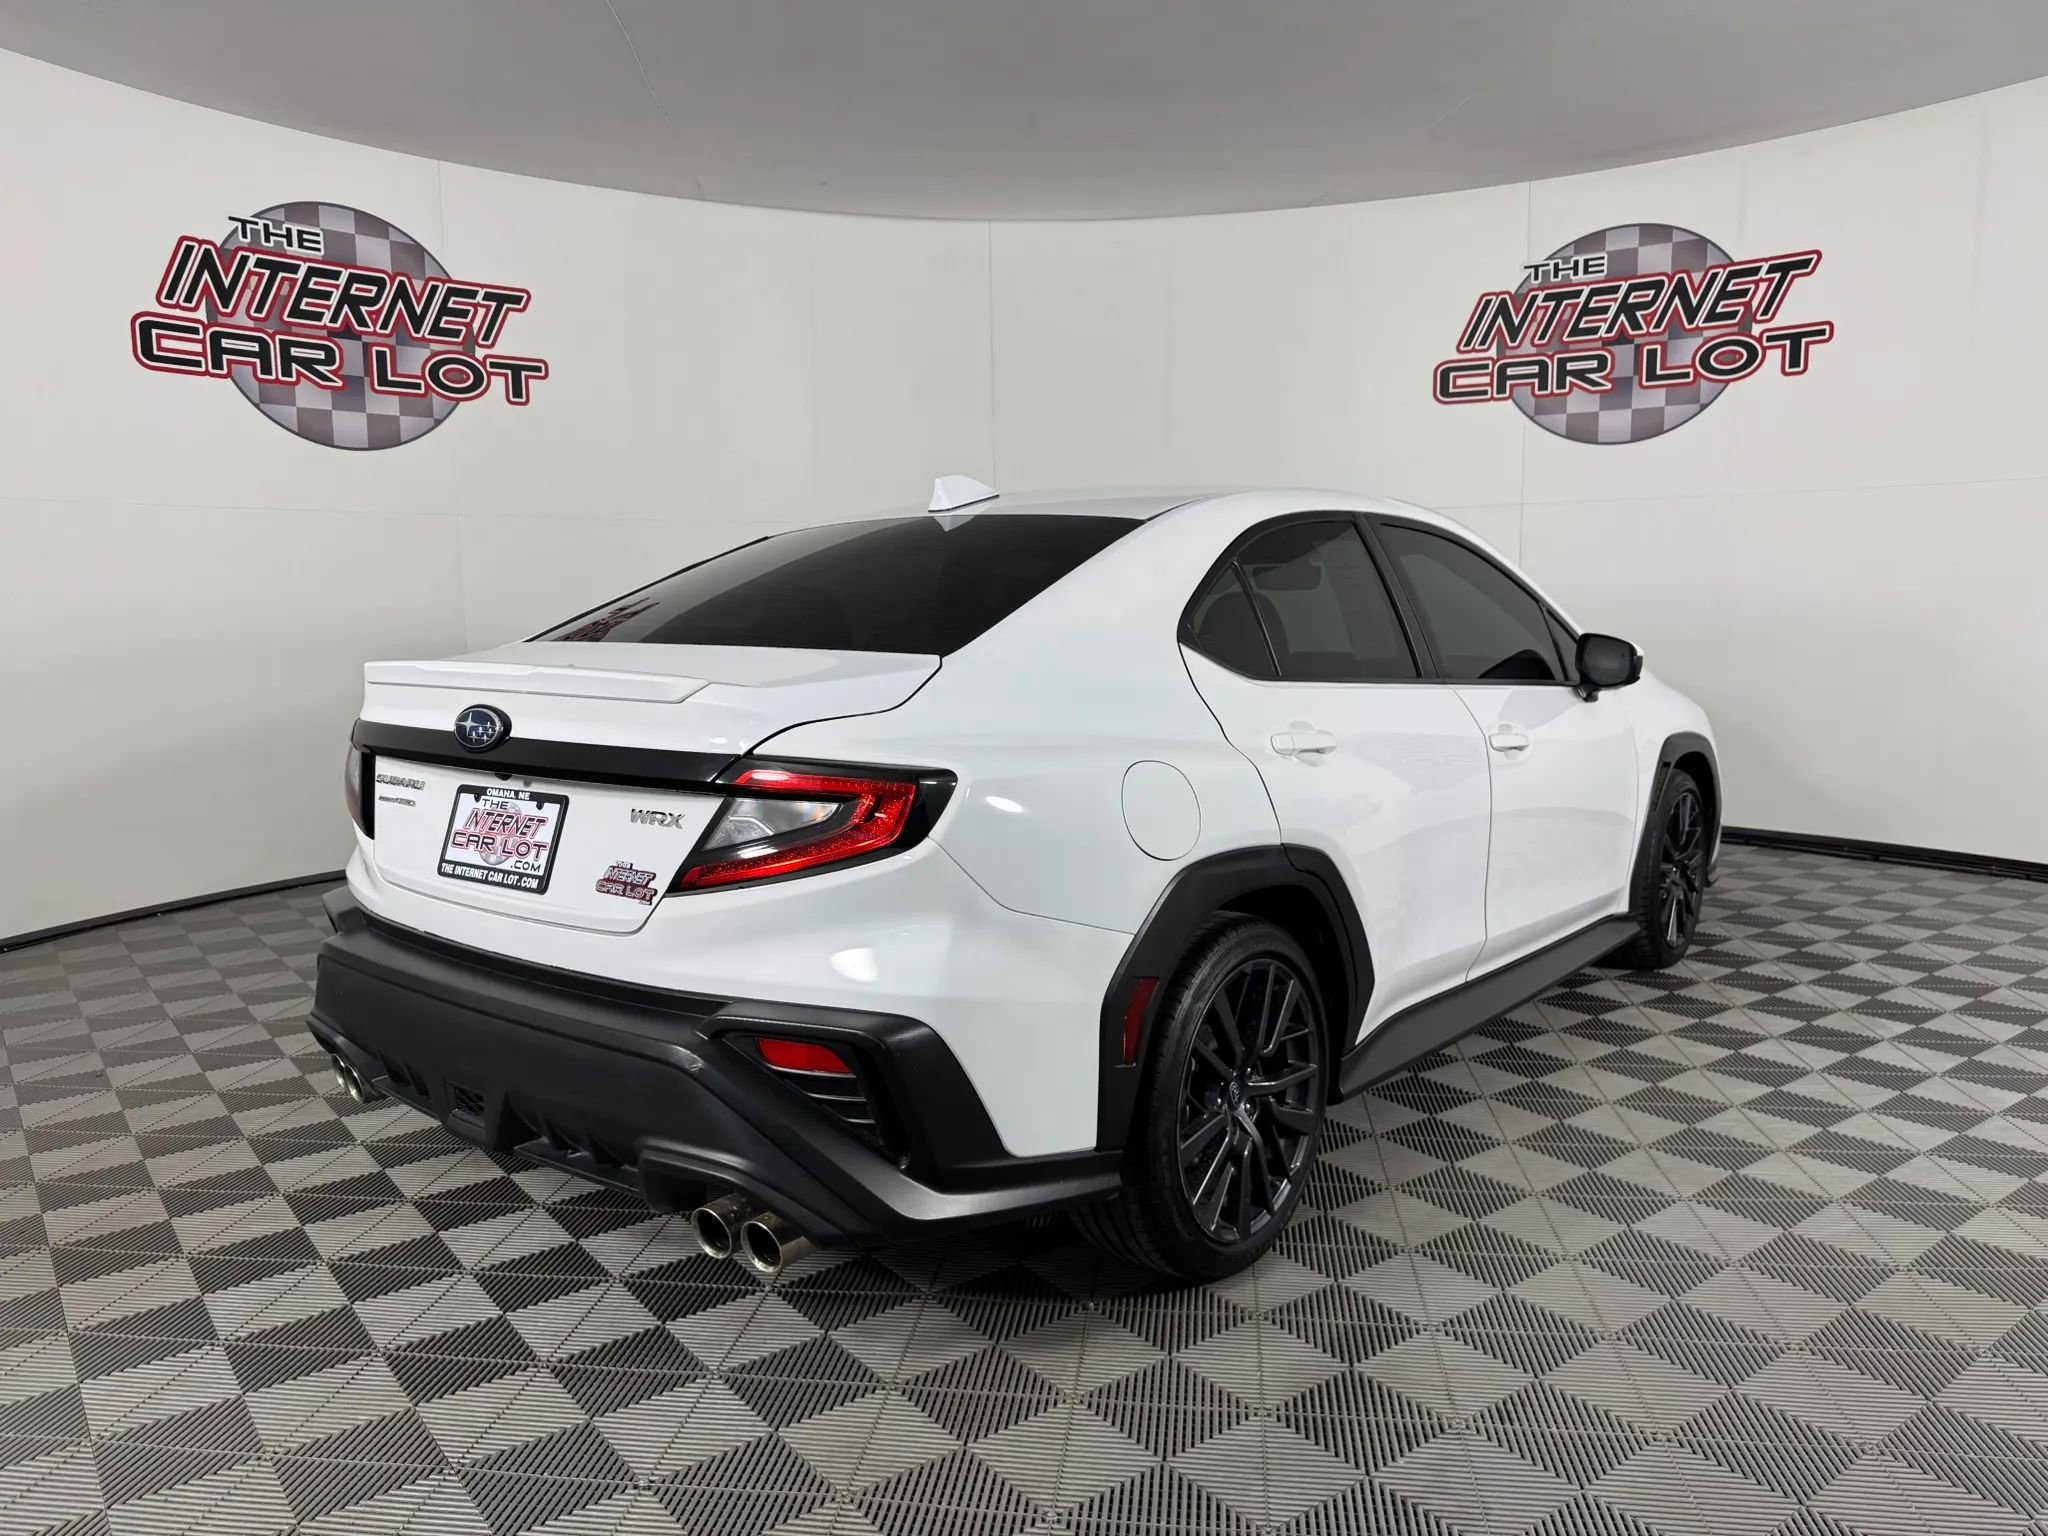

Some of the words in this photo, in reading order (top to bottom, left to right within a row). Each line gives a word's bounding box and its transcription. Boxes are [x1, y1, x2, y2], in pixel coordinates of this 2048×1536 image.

[228, 214, 325, 255] THE
[1523, 254, 1607, 282] THE
[158, 239, 530, 346] INTERNET
[1459, 253, 1819, 350] INTERNET
[135, 315, 343, 387] CAR
[372, 346, 546, 402] LOT
[1436, 350, 1612, 402] CAR
[1642, 325, 1830, 385] LOT
[376, 774, 426, 791] SUBARU
[518, 791, 531, 801] NE
[482, 798, 509, 810] THE
[464, 809, 548, 838] INTERNET
[630, 808, 685, 829] WRX
[451, 830, 497, 854] CAR
[501, 839, 548, 860] LOT
[441, 862, 455, 874] THE
[454, 865, 488, 880] INTERNET
[488, 870, 504, 883] CAR
[510, 859, 541, 873] .COM
[595, 879, 625, 895] CAR
[625, 886, 657, 901] LOT
